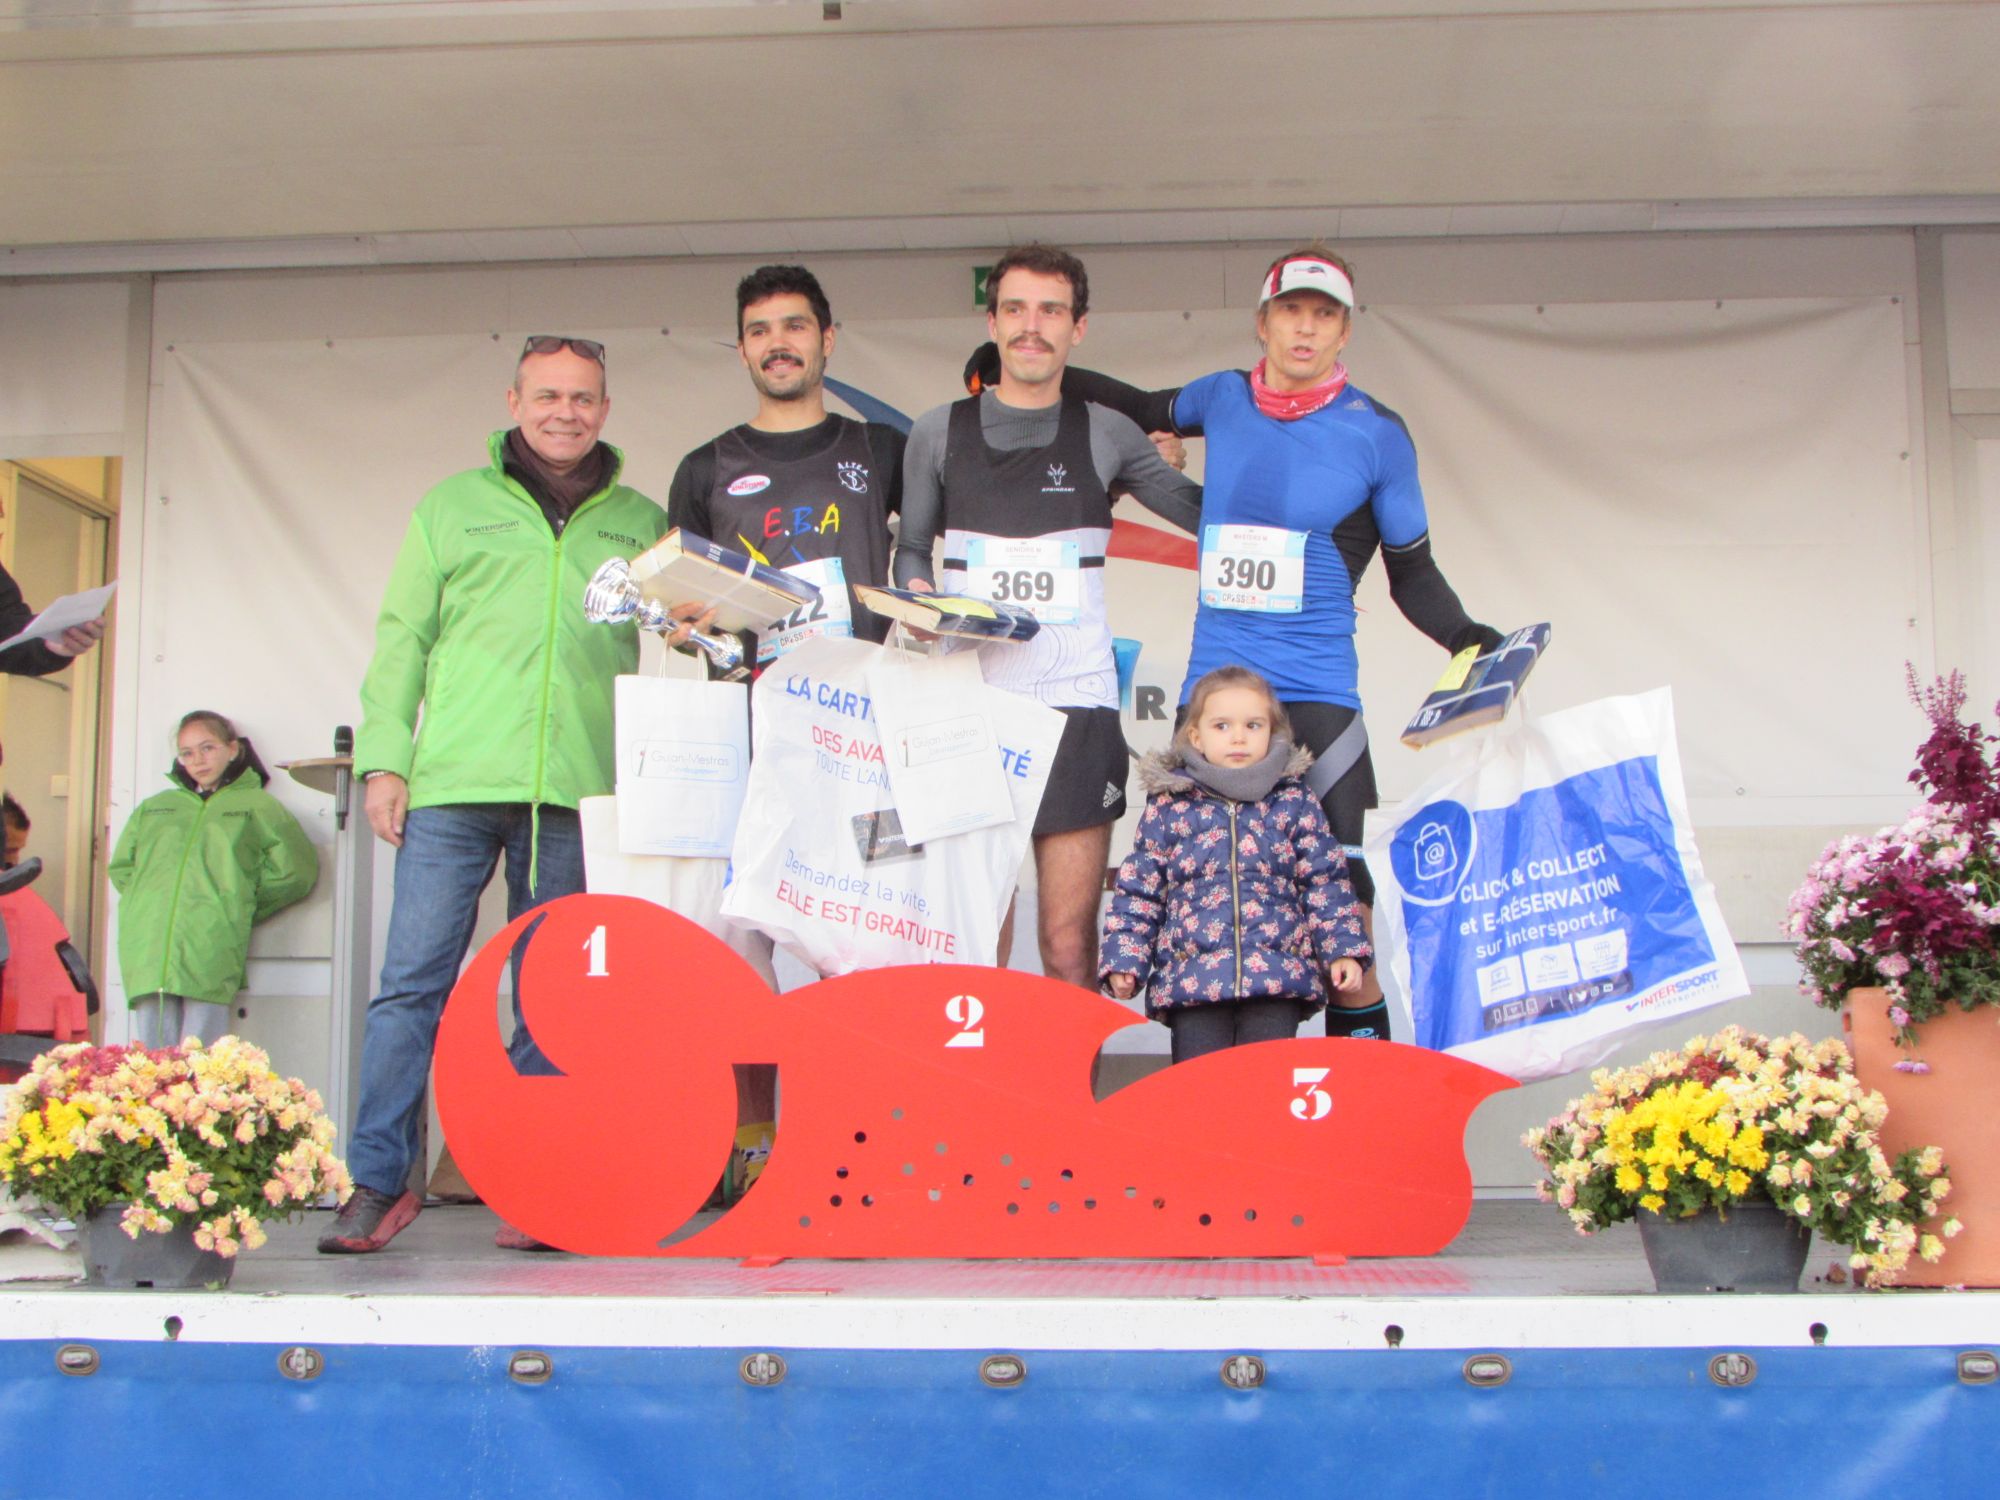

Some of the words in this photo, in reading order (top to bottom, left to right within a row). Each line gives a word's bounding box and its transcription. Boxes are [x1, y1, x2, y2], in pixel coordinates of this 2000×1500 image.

[991, 570, 1054, 601] 369
[1217, 557, 1276, 591] 390
[786, 674, 811, 700] LA
[817, 683, 876, 723] CART
[812, 725, 842, 754] DES
[846, 739, 885, 765] AVA
[814, 749, 850, 782] TOUTE
[857, 767, 891, 791] L'AN
[998, 745, 1032, 778] TÉ
[785, 849, 870, 896] Demandez
[877, 880, 893, 902] la
[900, 889, 931, 917] vite,
[1460, 872, 1510, 904] CLICK
[1512, 867, 1525, 886] &
[1528, 843, 1606, 880] COLLECT
[776, 880, 815, 916] ELLE
[821, 901, 861, 926] EST
[865, 911, 956, 955] GRATUITE
[1460, 917, 1478, 936] et
[1483, 873, 1621, 932] E-RÉSERVATION
[582, 925, 610, 976] 1
[1476, 937, 1502, 959] sur
[1505, 906, 1618, 949] intersport.fr
[1640, 969, 1719, 1008] INTERSPORT
[944, 995, 985, 1048] 2
[1290, 1068, 1333, 1120] 3
